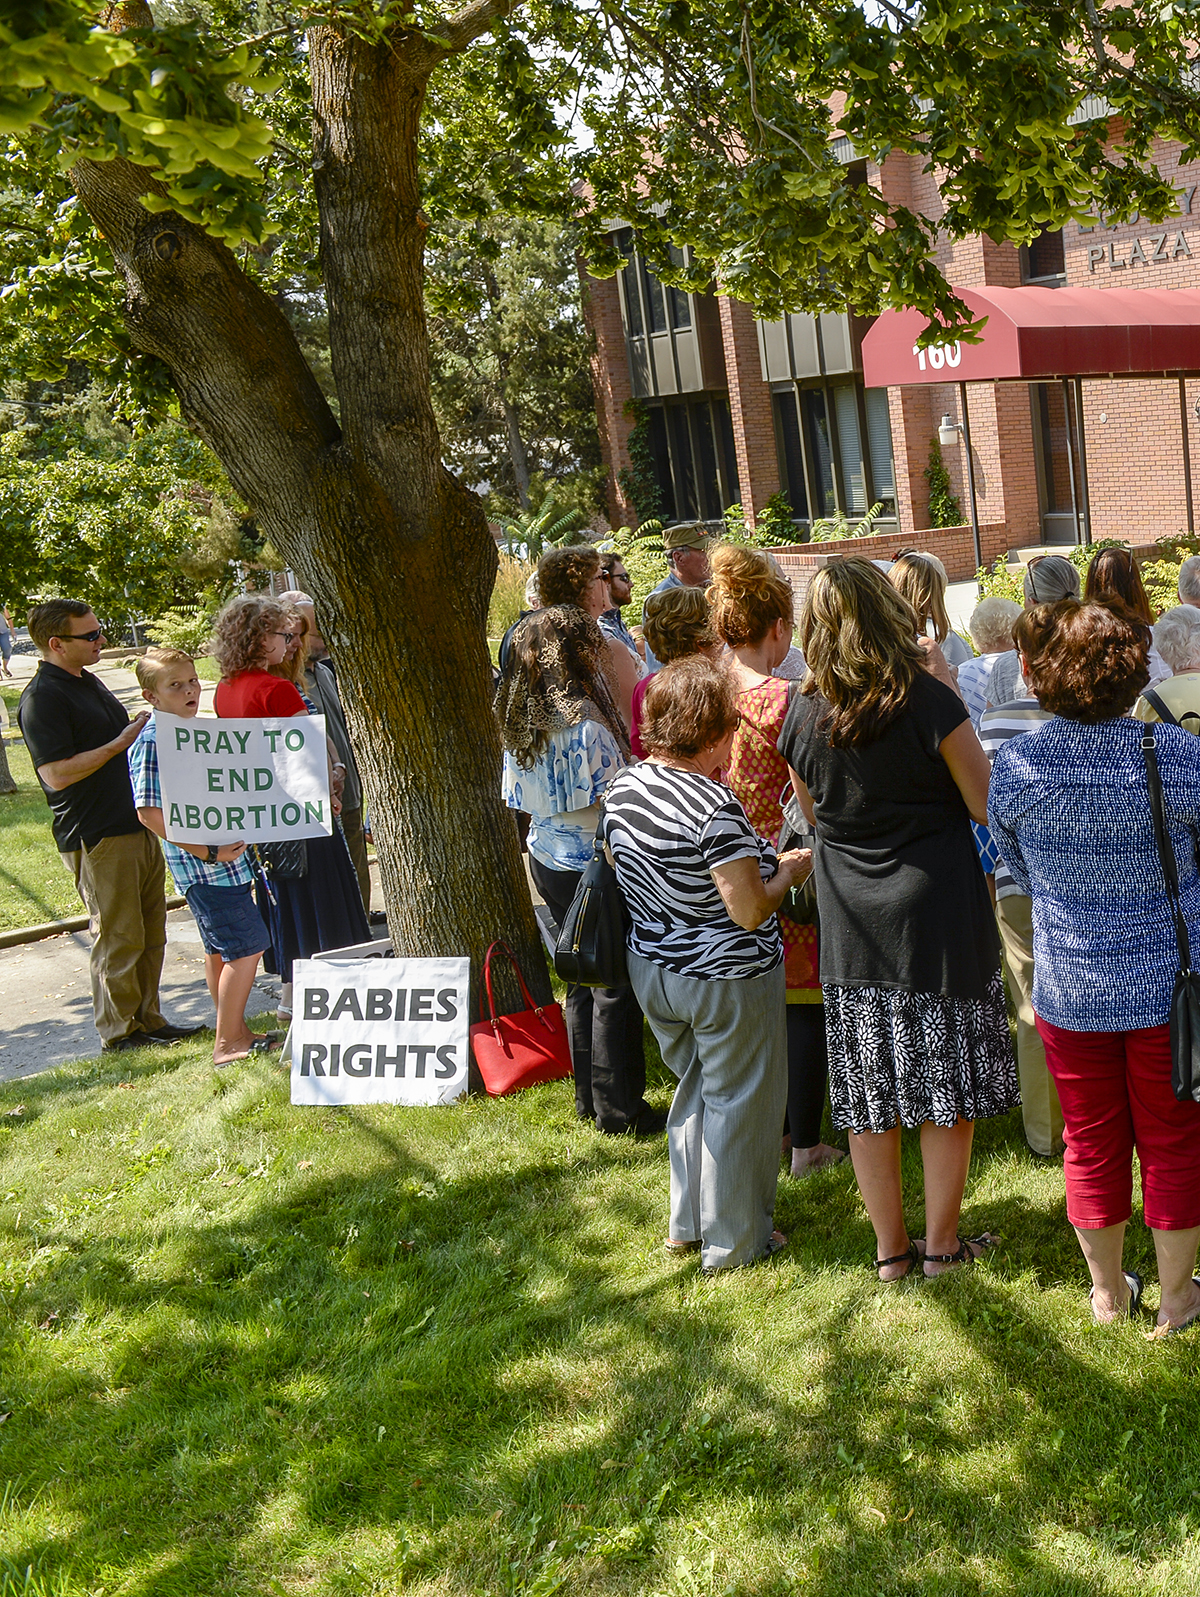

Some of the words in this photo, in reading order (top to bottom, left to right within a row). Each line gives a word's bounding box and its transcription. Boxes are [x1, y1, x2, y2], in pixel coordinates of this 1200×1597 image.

[1087, 230, 1192, 271] PLAZA
[912, 339, 962, 371] 160
[174, 727, 251, 754] PRAY
[263, 728, 305, 753] TO
[206, 767, 274, 793] END
[169, 799, 324, 831] ABORTION
[303, 987, 458, 1022] BABIES
[300, 1043, 458, 1079] RIGHTS
